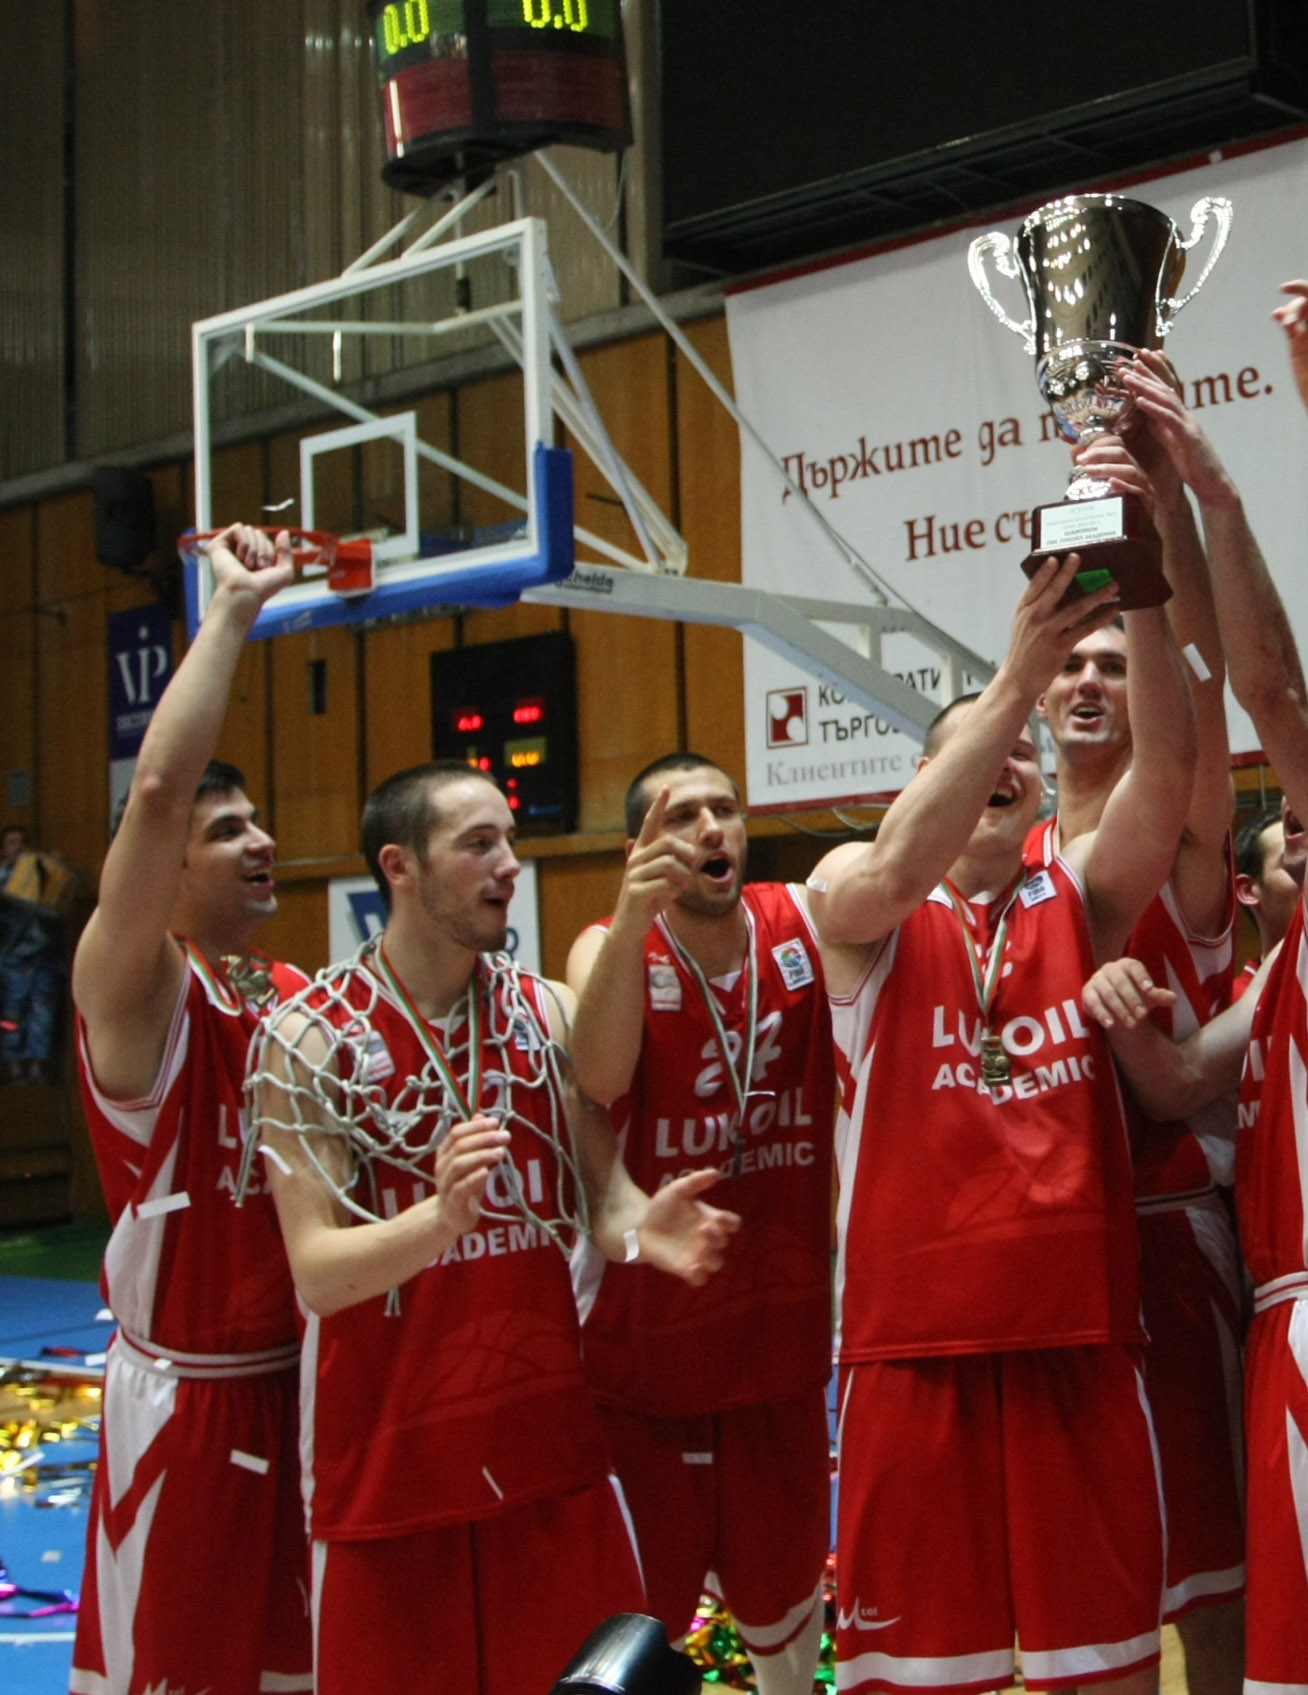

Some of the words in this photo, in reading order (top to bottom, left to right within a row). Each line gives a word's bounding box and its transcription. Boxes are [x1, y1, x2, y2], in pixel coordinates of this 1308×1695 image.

[978, 416, 1024, 467] да
[903, 517, 986, 562] Ние
[766, 754, 902, 788] Клиентите
[932, 999, 1091, 1060] LUOIL
